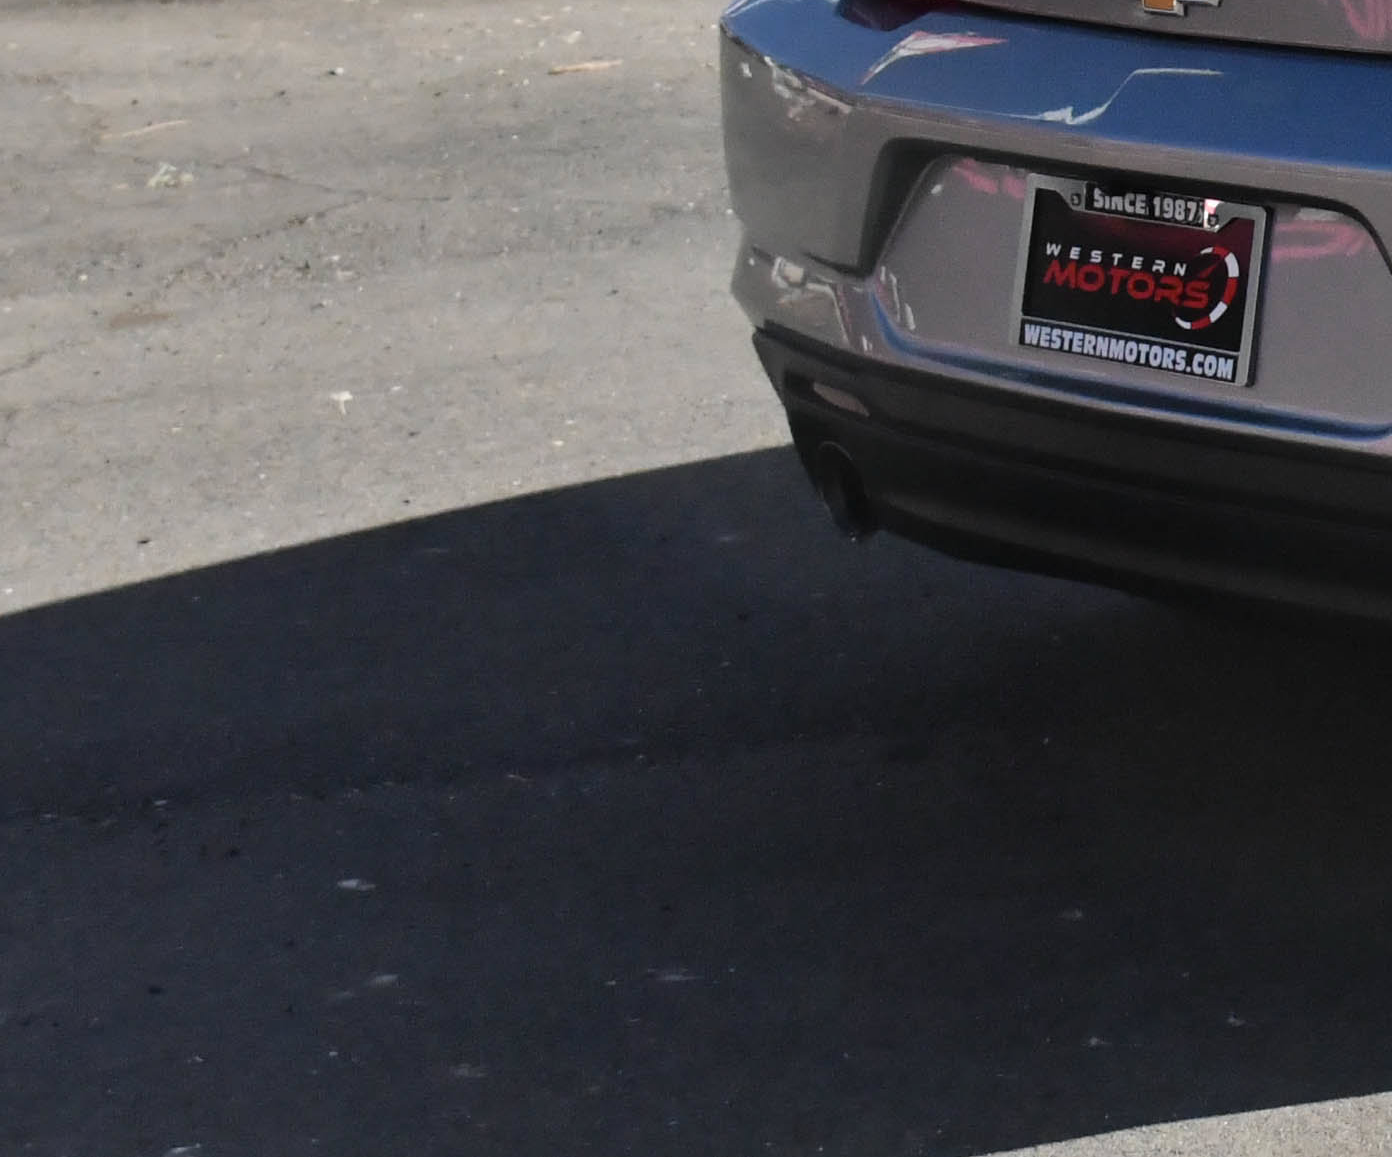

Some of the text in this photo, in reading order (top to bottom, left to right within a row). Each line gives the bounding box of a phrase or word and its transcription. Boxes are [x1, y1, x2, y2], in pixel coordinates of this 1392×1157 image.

[1153, 196, 1198, 222] 1987
[1045, 242, 1187, 276] WESTERN
[1043, 259, 1211, 309] MOTORS
[1024, 324, 1235, 381] WESTERNMOTORS.COM
